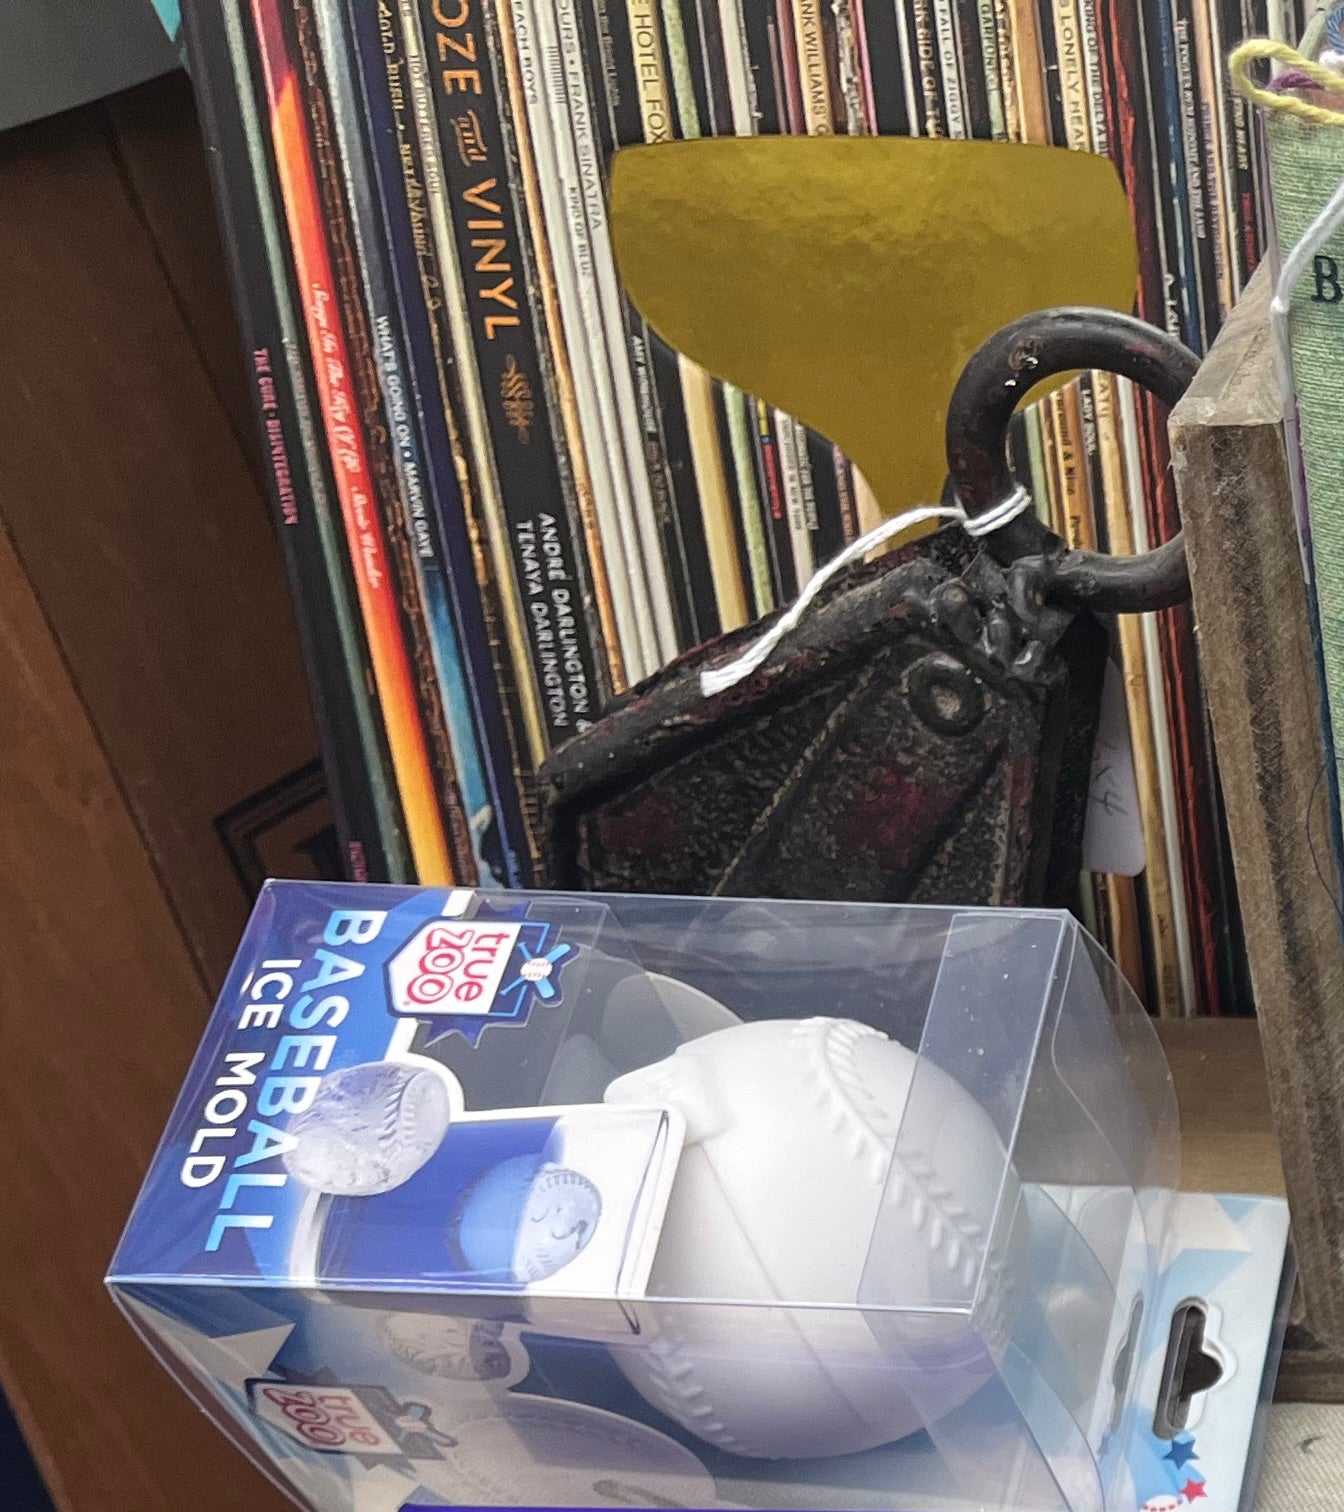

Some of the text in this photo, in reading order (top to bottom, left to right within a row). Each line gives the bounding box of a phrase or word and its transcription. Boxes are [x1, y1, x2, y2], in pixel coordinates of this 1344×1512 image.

[939, 4, 952, 42] FALL
[1086, 37, 1097, 54] OF
[633, 13, 660, 91] HOTEL
[943, 51, 955, 68] OF
[1060, 15, 1081, 94] LONELY
[1089, 62, 1100, 85] THE
[567, 70, 588, 144] FRANK
[645, 98, 668, 145] FOX
[946, 78, 962, 125] ZIGGY
[1091, 92, 1106, 135] DELTA
[576, 147, 603, 231] SINATRA
[462, 178, 521, 340] VINYL
[254, 348, 272, 374] THE
[257, 376, 278, 411] CURE
[386, 374, 409, 422] GOING
[395, 425, 412, 448] ON
[402, 462, 427, 520] MARVIN
[413, 519, 434, 558] GAYE
[538, 511, 568, 583] ANDRÉ
[515, 519, 569, 729] TENAYA DARLINGTON
[551, 589, 590, 719] DARLINGTON
[453, 930, 510, 1003] true
[180, 957, 302, 1188] ICE MOLD
[204, 910, 388, 1253] BASEBALL
